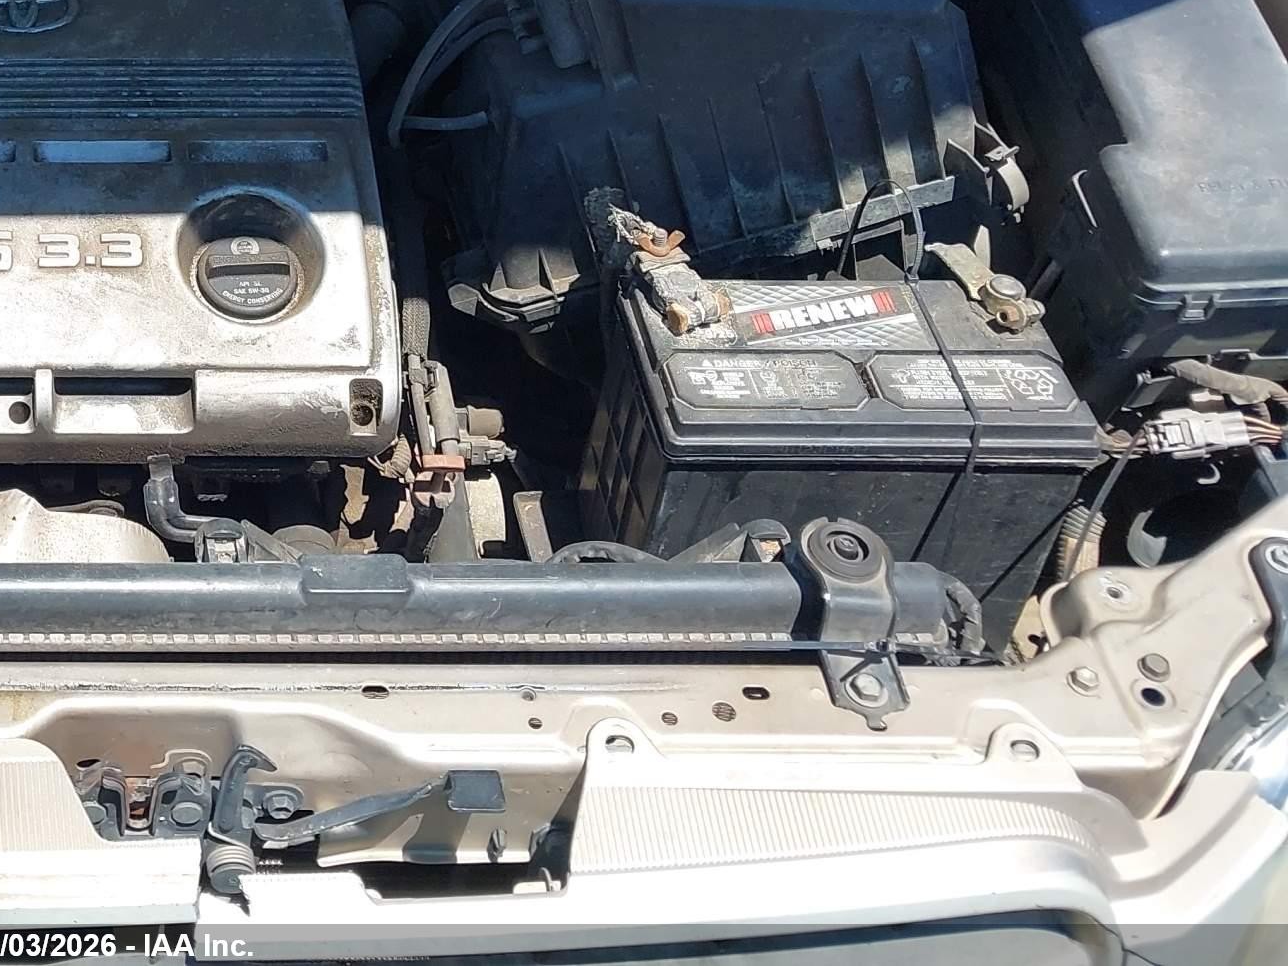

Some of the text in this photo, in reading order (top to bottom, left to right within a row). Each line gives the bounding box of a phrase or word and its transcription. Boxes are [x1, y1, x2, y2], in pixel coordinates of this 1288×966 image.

[37, 232, 144, 269] 3.3
[768, 294, 879, 331] RENEW
[714, 359, 762, 368] DANGER
